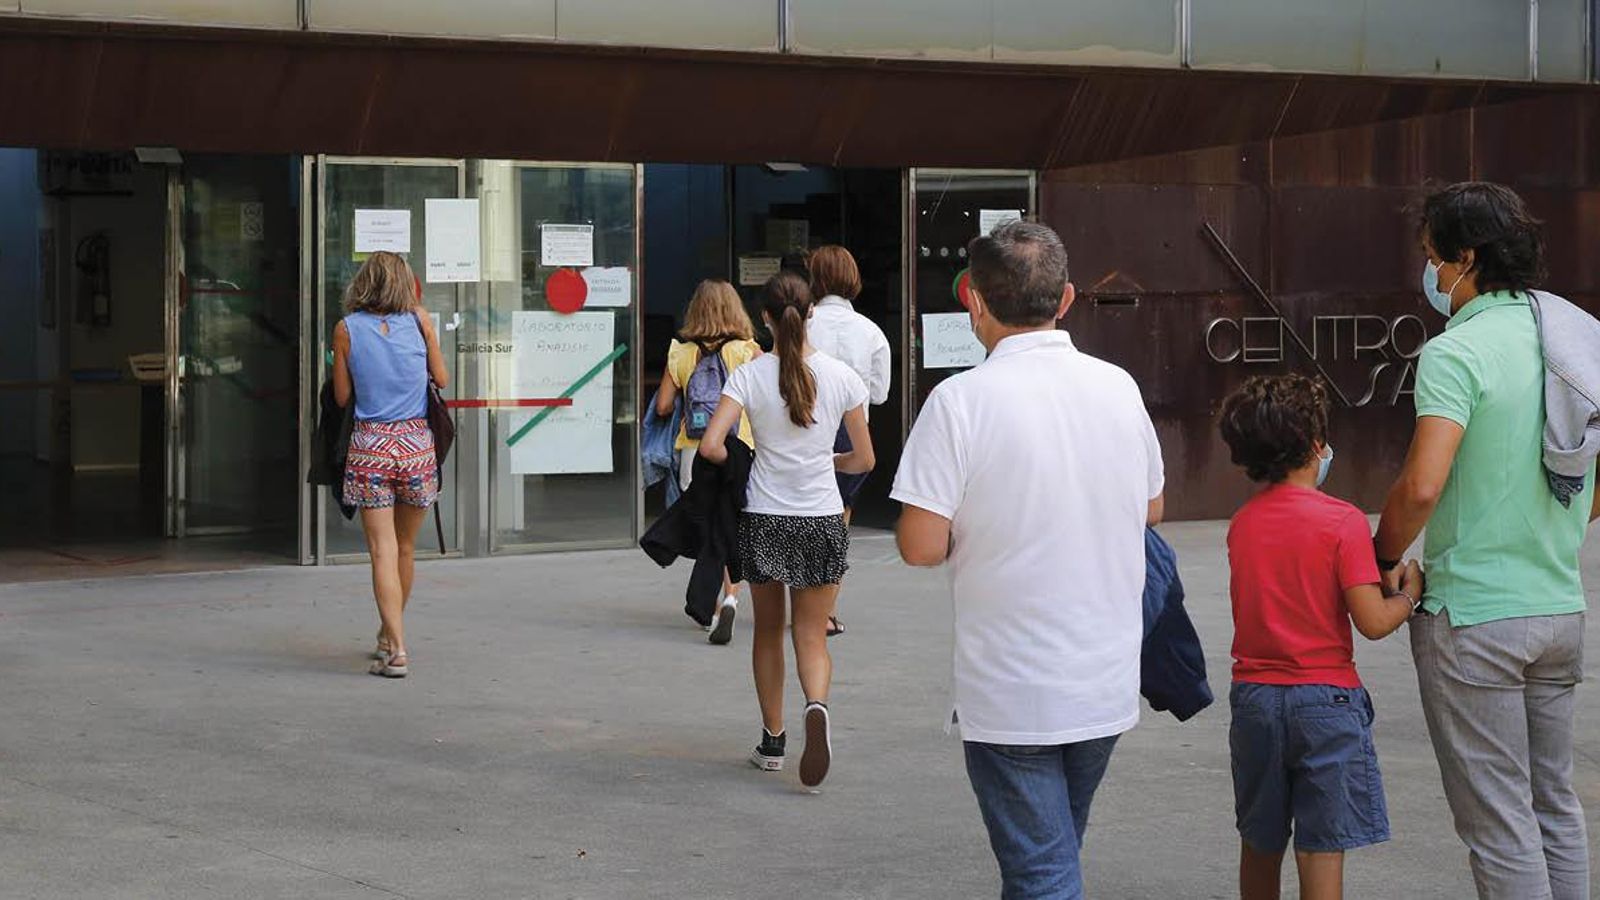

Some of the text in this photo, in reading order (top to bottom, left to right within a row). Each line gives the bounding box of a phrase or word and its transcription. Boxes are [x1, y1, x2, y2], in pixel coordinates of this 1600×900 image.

[458, 343, 513, 353] Galicia Sur
[1206, 315, 1427, 362] CENTRO
